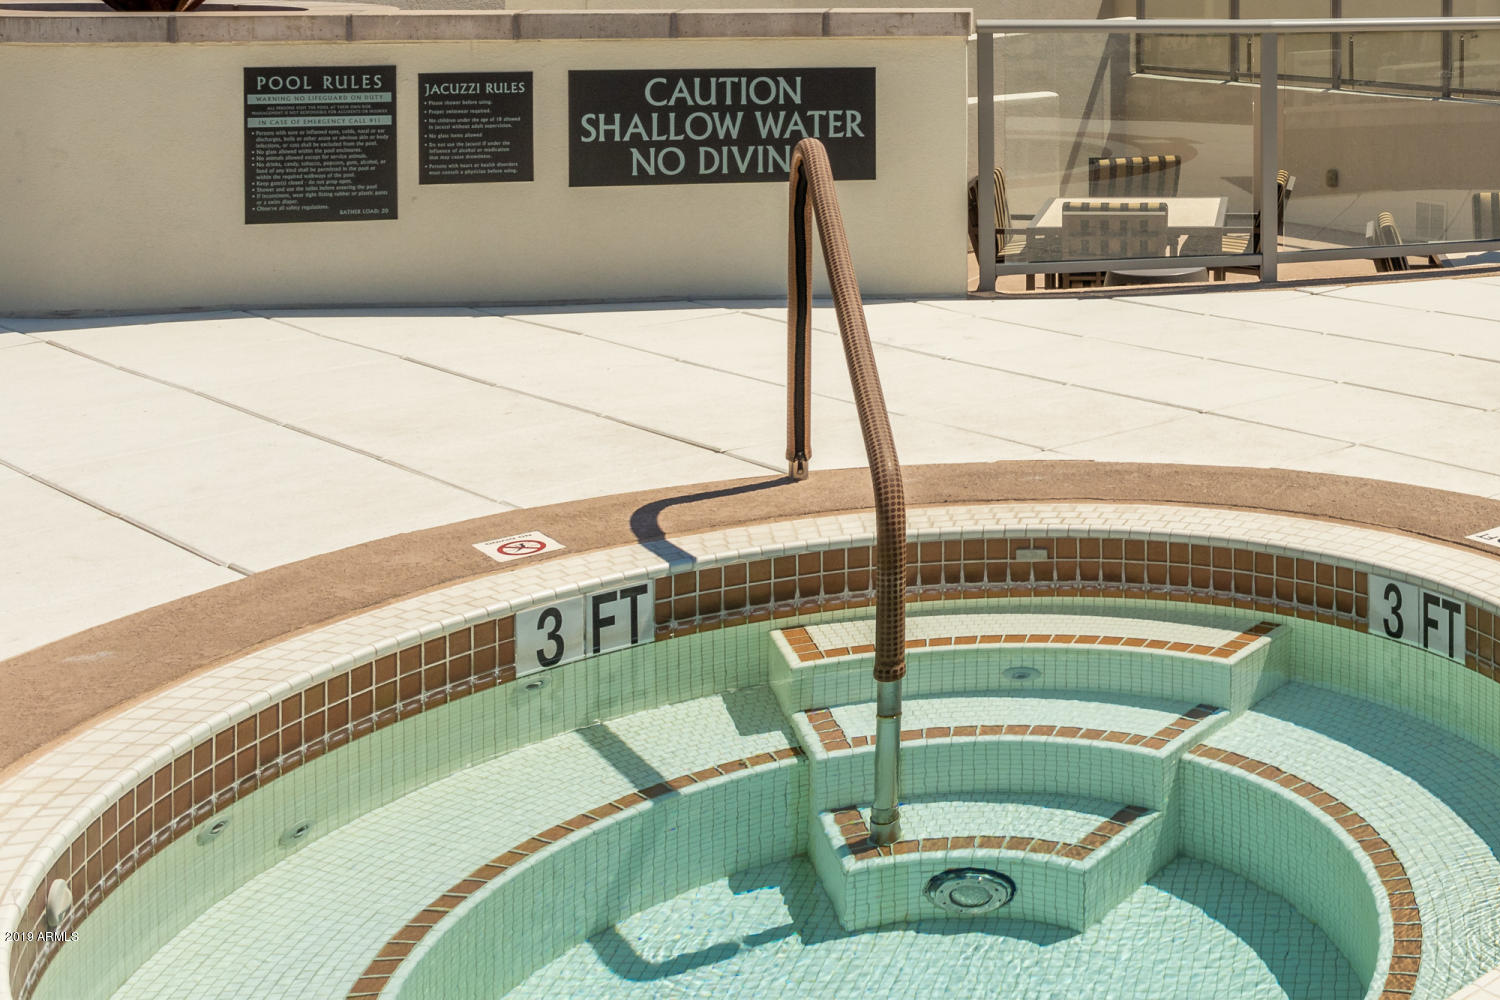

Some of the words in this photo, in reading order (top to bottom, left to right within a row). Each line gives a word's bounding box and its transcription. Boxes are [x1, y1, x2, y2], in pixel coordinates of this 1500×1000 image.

[257, 76, 312, 90] POOL
[323, 75, 382, 89] RULES
[425, 83, 480, 96] JACUZZI
[486, 82, 525, 93] RULES
[645, 77, 802, 106] CAUTION
[581, 112, 744, 142] SHALLOW
[755, 110, 864, 139] WATER
[630, 147, 686, 176] NO
[699, 145, 790, 175] DIVIN
[537, 607, 564, 667] 3
[592, 584, 648, 654] FT
[1384, 583, 1403, 638] 3
[1423, 592, 1461, 658] FT
